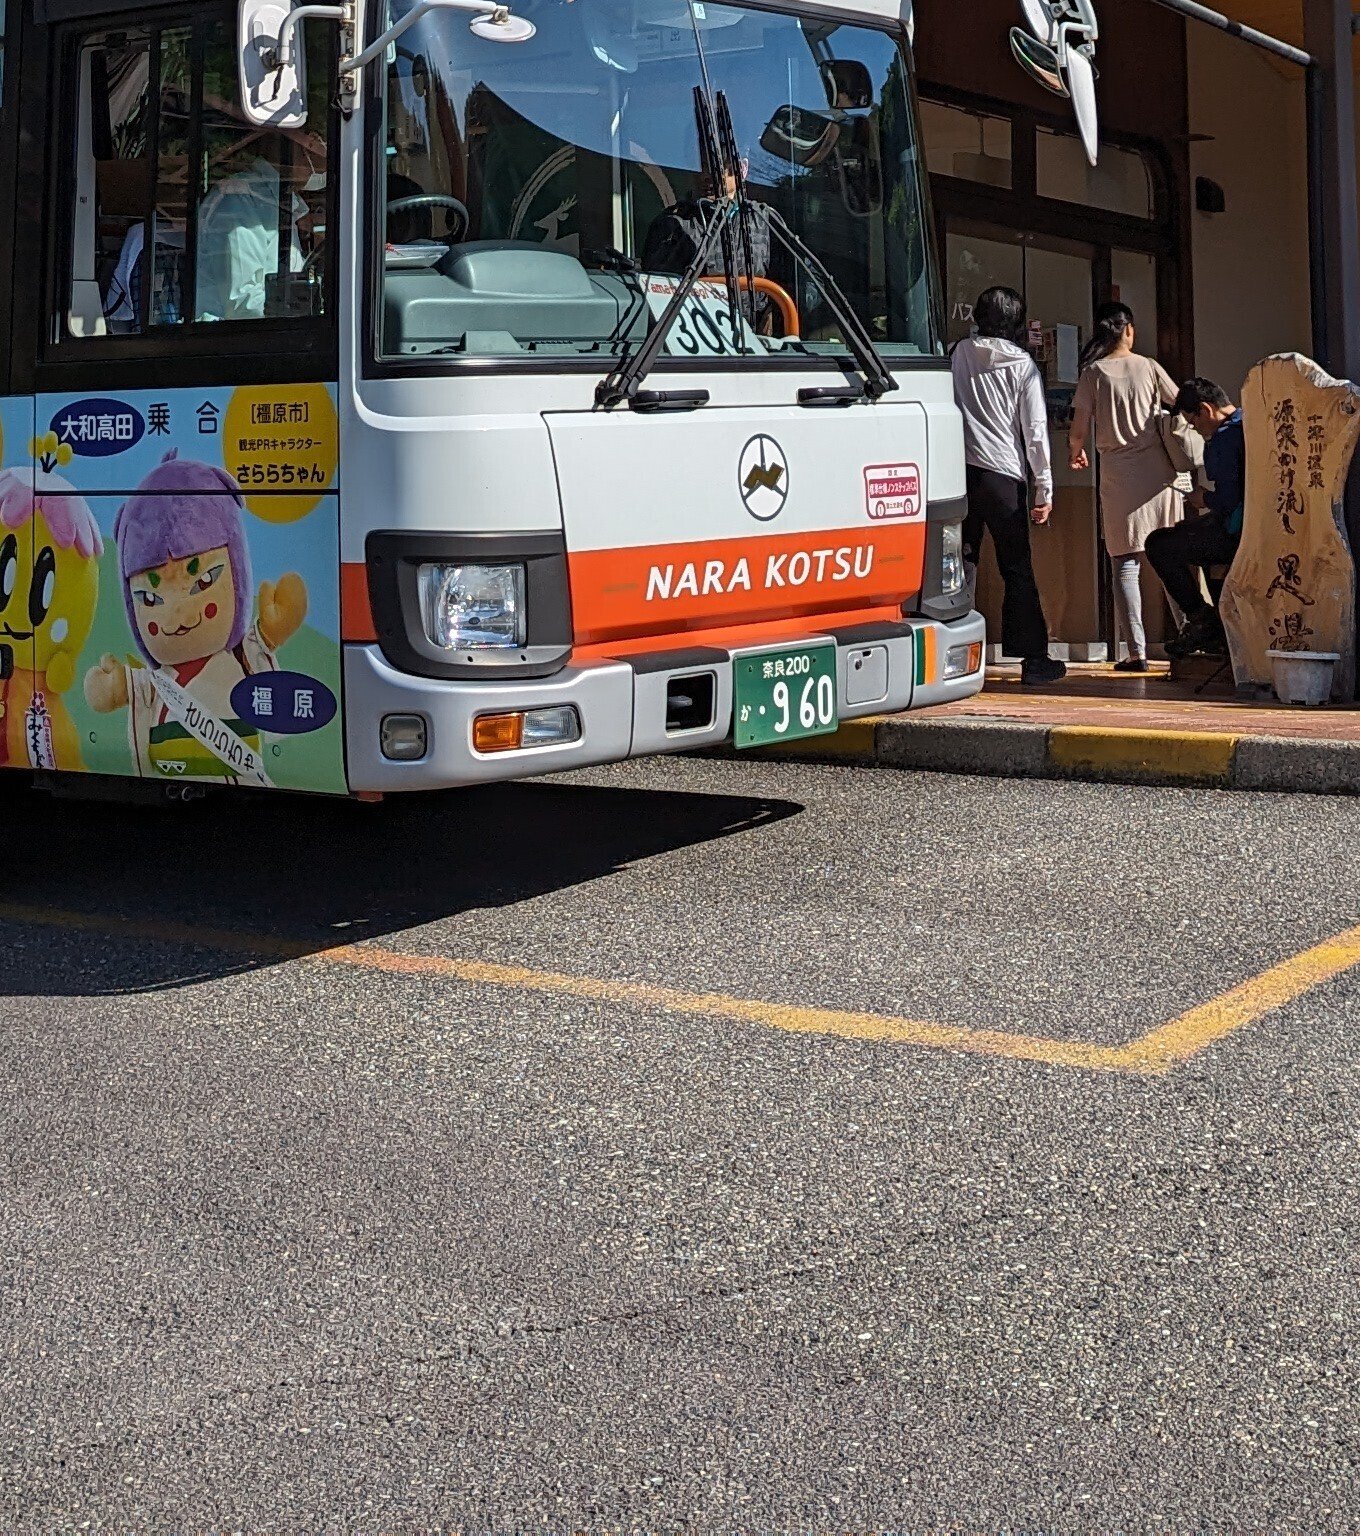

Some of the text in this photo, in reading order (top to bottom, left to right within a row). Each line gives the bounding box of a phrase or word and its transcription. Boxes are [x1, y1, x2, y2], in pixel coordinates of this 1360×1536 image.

[60, 414, 134, 441] 大和高田
[147, 400, 220, 436] 乗合
[238, 438, 322, 452] 観光PRキャラクター
[1307, 414, 1325, 489] 十津川温泉
[236, 464, 325, 484] さららちゃん
[1274, 398, 1304, 534] 源泉かけ流し
[645, 545, 875, 601] NARA KOTSU
[251, 686, 314, 720] 橿原
[740, 704, 751, 723] か
